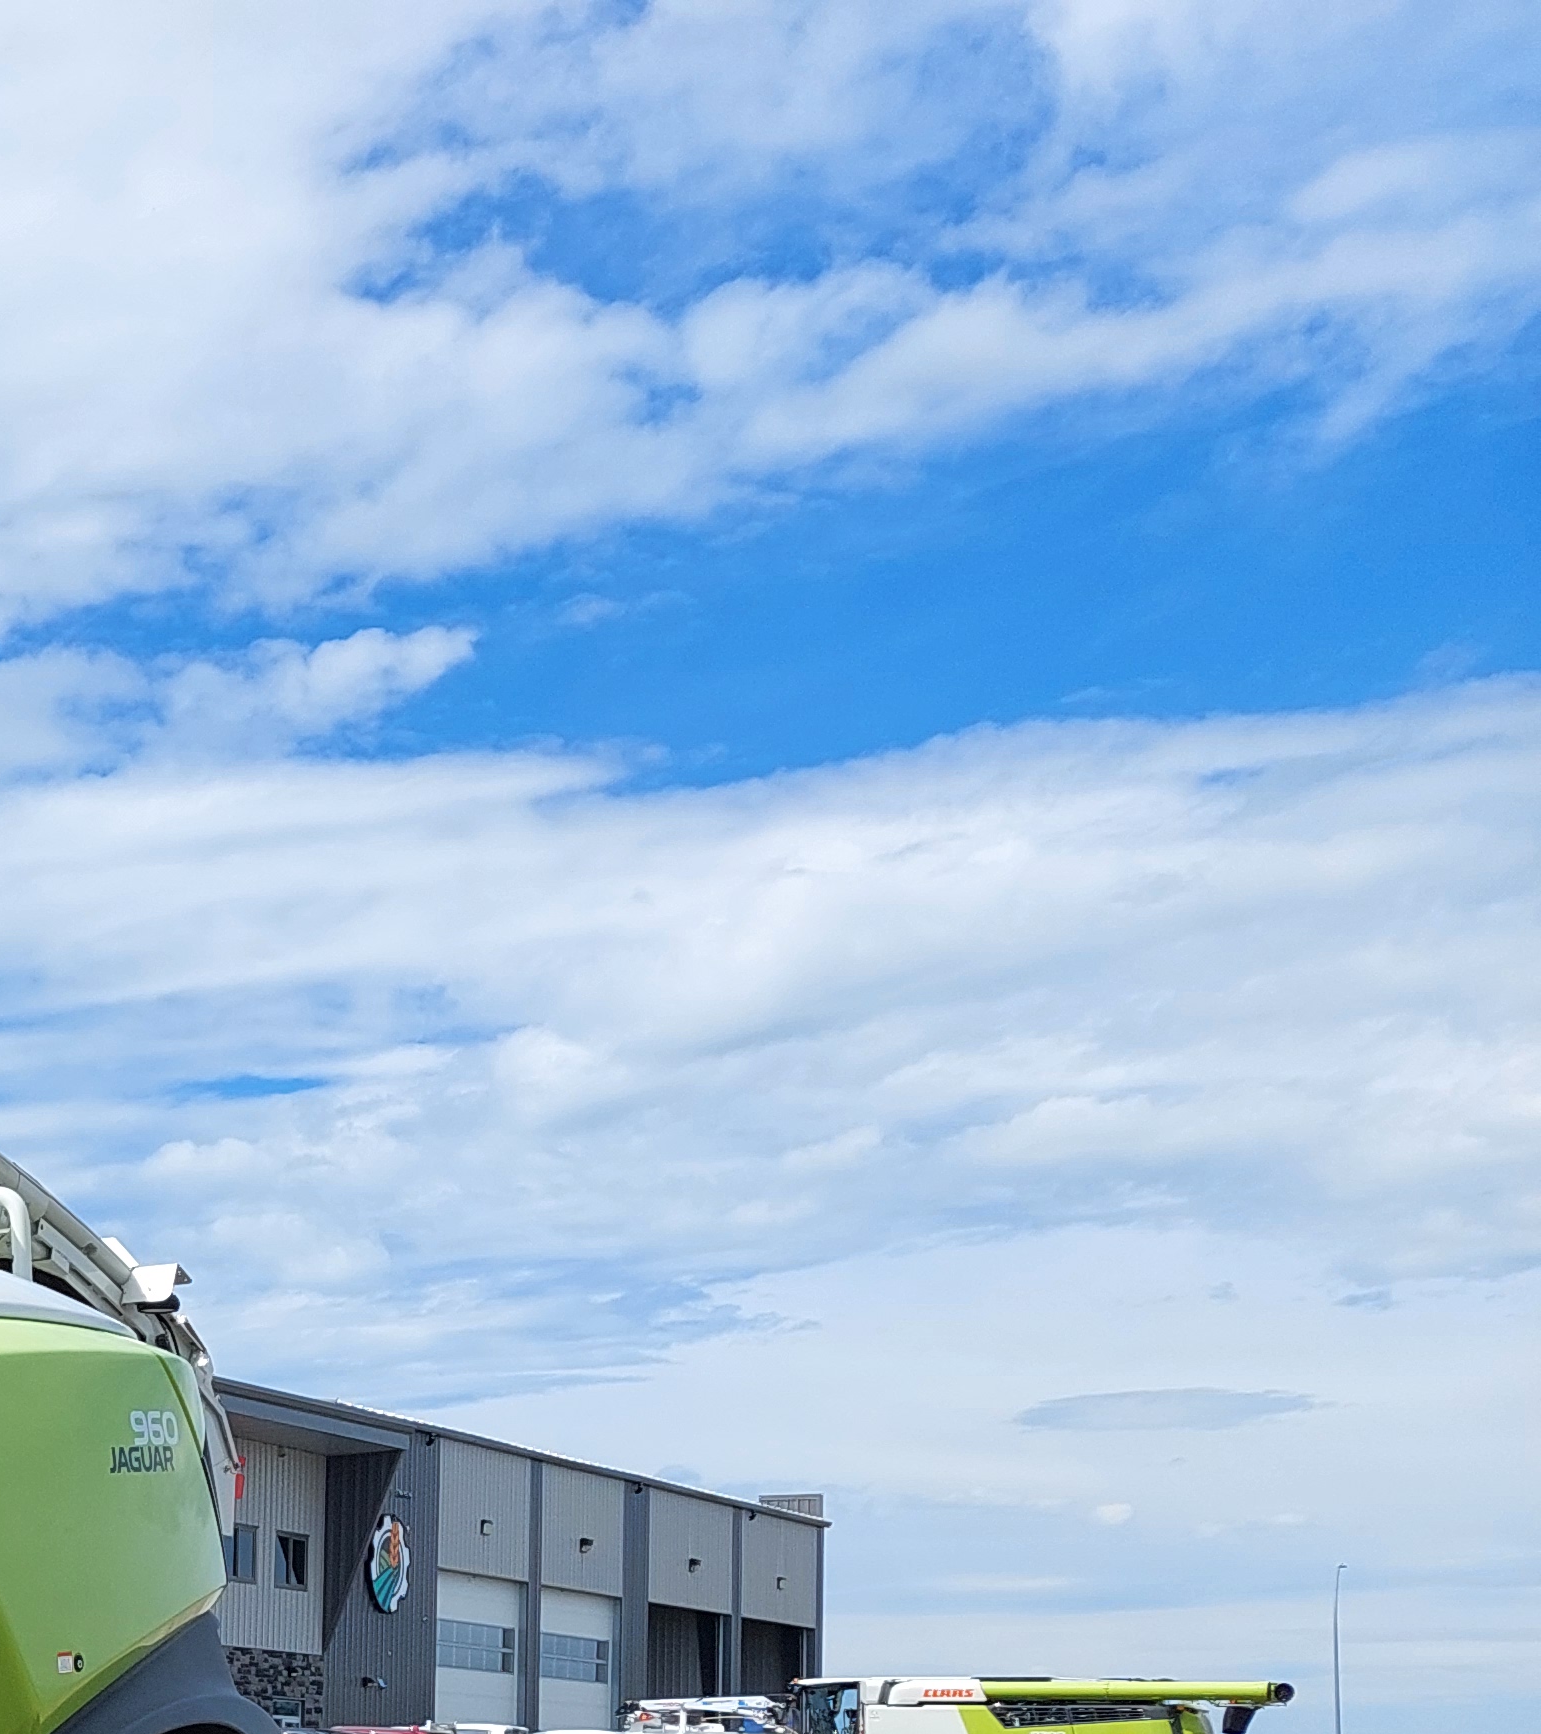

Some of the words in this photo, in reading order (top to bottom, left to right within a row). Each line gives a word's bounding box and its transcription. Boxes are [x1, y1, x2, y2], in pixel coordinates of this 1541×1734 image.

[130, 1410, 180, 1446] 960
[109, 1446, 175, 1473] JAGUAR
[923, 1688, 975, 1698] CLAAS
